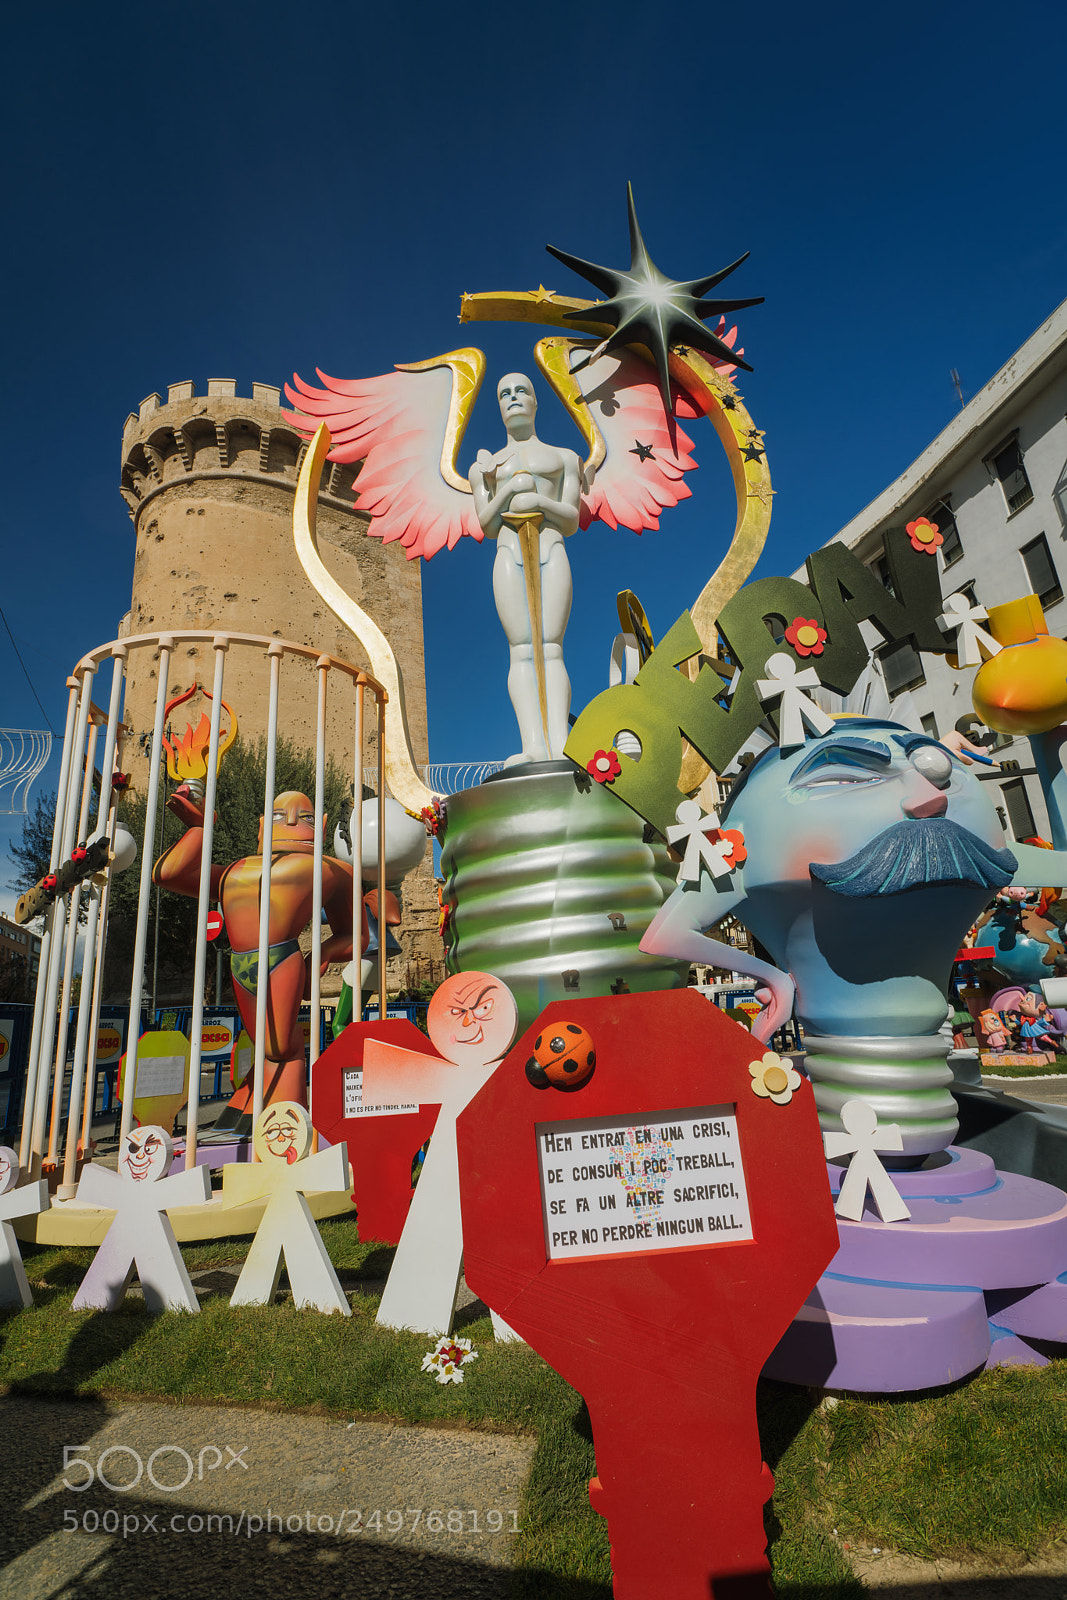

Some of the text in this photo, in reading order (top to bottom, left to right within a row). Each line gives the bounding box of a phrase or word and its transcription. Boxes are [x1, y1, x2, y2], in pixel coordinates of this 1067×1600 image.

[98, 1037, 120, 1048] acsa
[202, 1033, 230, 1043] acsa
[544, 1121, 730, 1153] HEM ENTRAT EN UNA CRISI,
[548, 1151, 735, 1184] DE CONSUM I POC TREBALL,
[550, 1182, 739, 1215] SE FA UN ALTRE SACRIFICI,
[552, 1214, 743, 1247] PER NO PERDRE NINGUN BALL.
